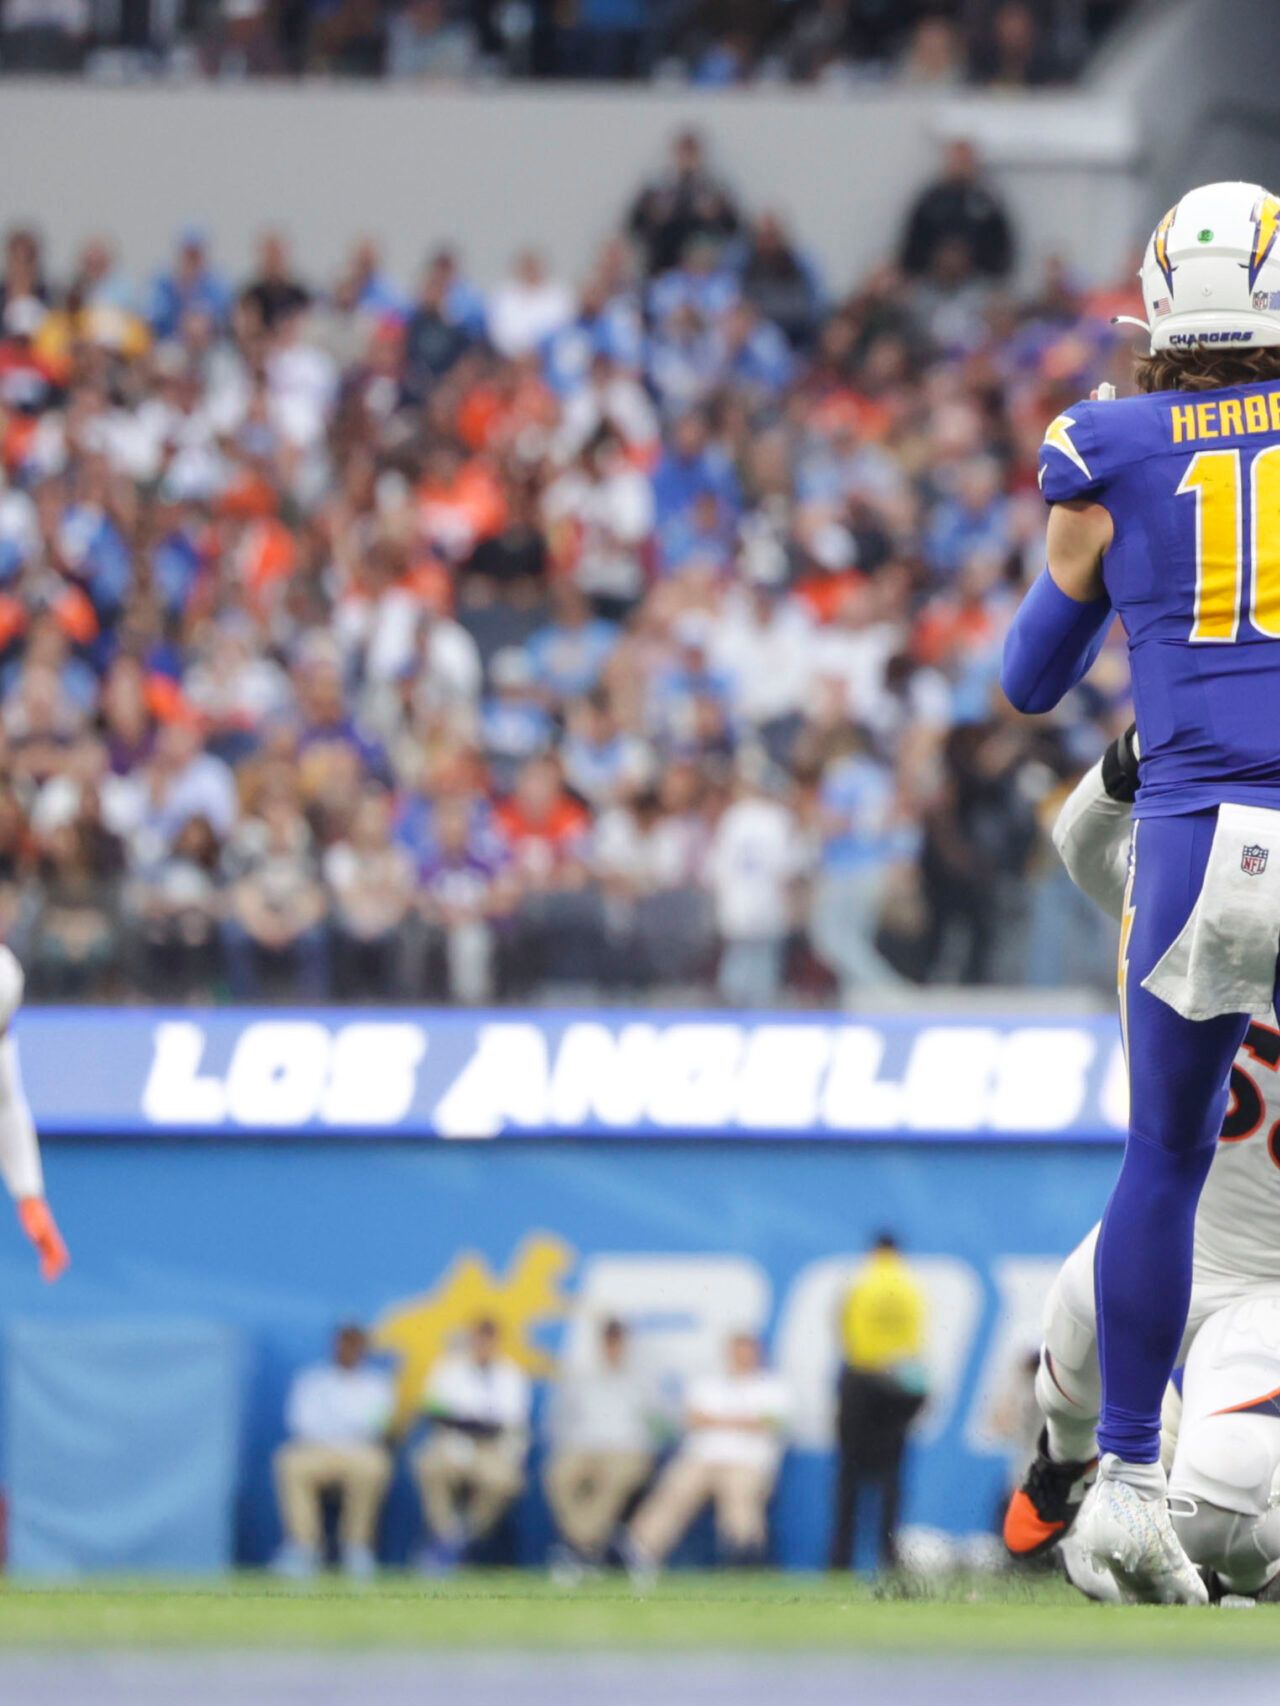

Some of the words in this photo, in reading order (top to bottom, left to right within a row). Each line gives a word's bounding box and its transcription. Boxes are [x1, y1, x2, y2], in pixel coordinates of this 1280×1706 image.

[1169, 331, 1254, 345] CHARGERS
[141, 1021, 427, 1125] LOS
[431, 1022, 1095, 1138] ANGELES
